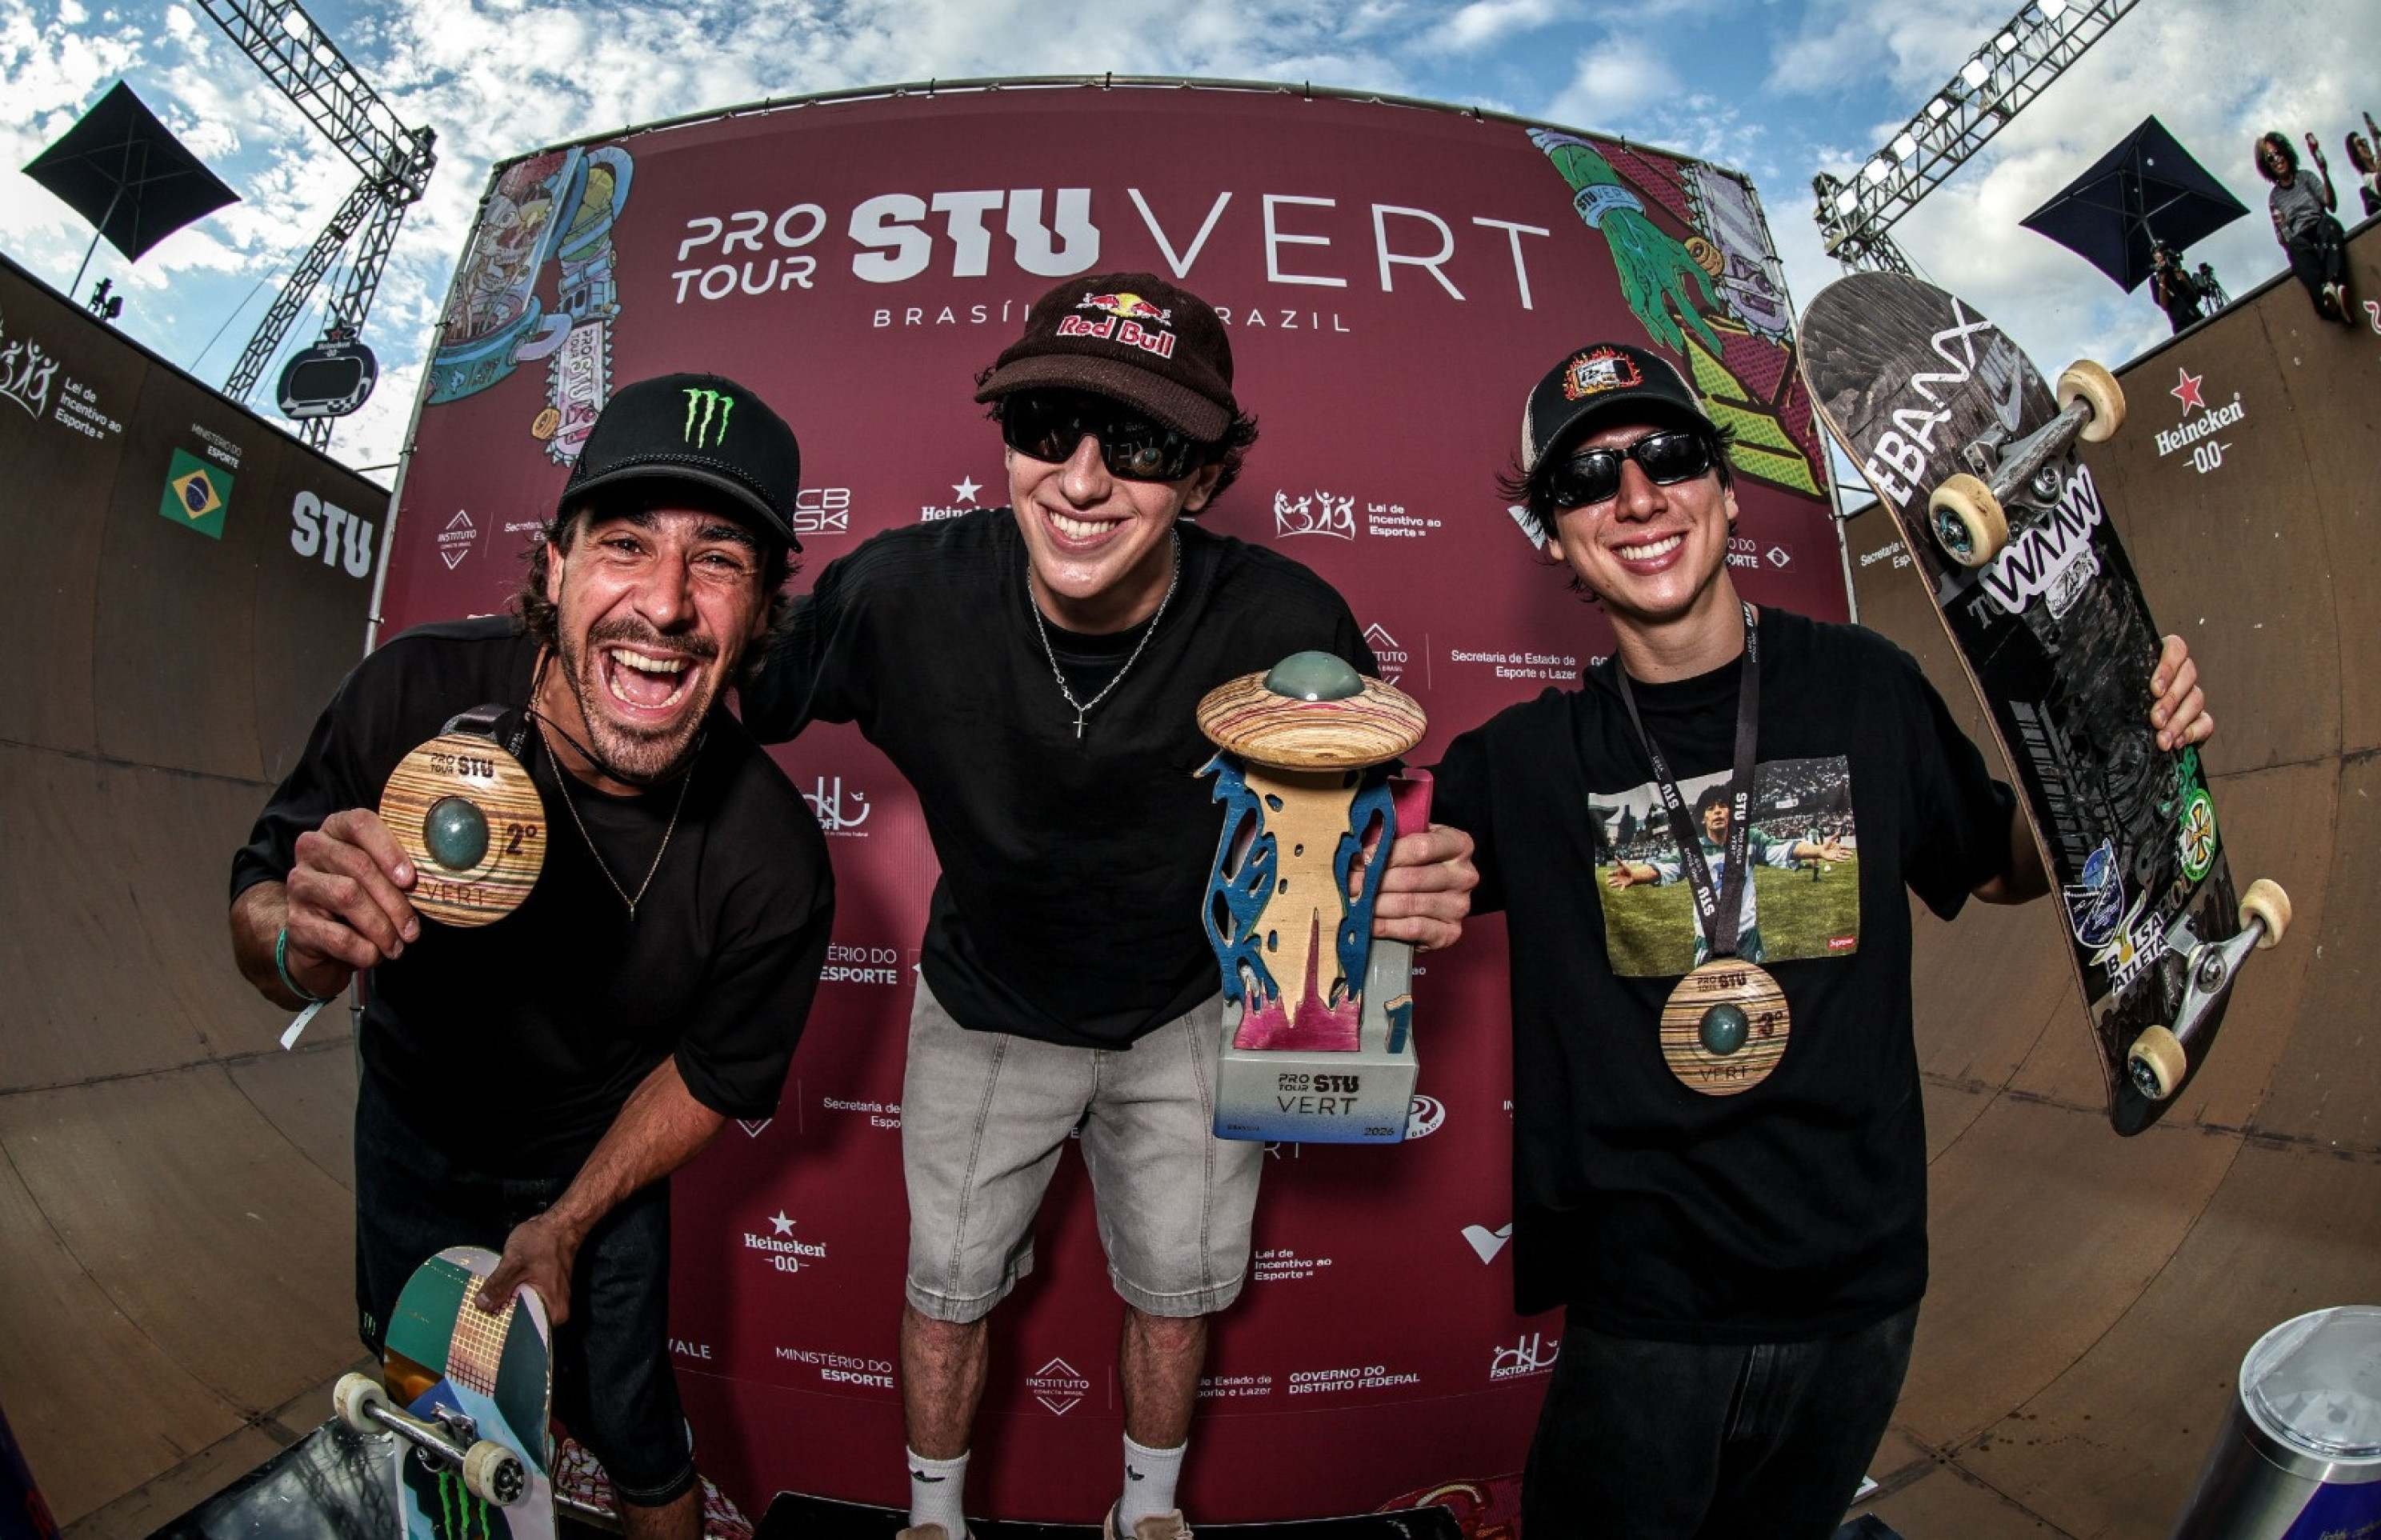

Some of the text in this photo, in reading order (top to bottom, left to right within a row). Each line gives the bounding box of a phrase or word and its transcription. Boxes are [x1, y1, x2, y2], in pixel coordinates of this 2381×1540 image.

[678, 203, 826, 262] PRO
[848, 188, 1551, 310] STU VERT
[671, 255, 817, 305] TOUR
[874, 301, 1030, 327] BRASÍ
[1057, 315, 1176, 359] Red Bull
[65, 377, 97, 402] Lei de
[1864, 295, 1992, 507] EBANX
[61, 392, 122, 433] Incentivo ao
[55, 408, 95, 438] Esporte
[2155, 399, 2245, 457] Heineken
[1368, 502, 1404, 514] Lei de
[1369, 514, 1441, 528] Incentivo ao
[291, 491, 374, 578] STU
[1370, 526, 1416, 538] Esporte
[1727, 553, 1759, 569] ORTE
[1451, 650, 1575, 666] Secretaria de Estado de
[1495, 666, 1536, 679] Esporte
[1549, 669, 1577, 679] Lazer
[458, 756, 494, 778] STU
[1735, 792, 1748, 821] STU
[423, 882, 487, 905] VERT
[870, 949, 897, 964] DO
[2114, 934, 2171, 993] ATLETA
[819, 966, 898, 985] ESPORTE
[1719, 971, 1747, 989] STU
[1279, 1074, 1311, 1084] PRO
[1699, 1065, 1749, 1082] VERT
[1279, 1074, 1359, 1094] TOUR STU
[823, 1098, 882, 1114] Secretaria
[1277, 1096, 1359, 1115] VERT
[871, 1115, 901, 1130] Espo
[743, 1233, 826, 1258] Heineken
[1255, 1249, 1294, 1259] Lei de
[1255, 1258, 1332, 1270] Incentivo ao
[1255, 1270, 1303, 1282] Esporte
[776, 1346, 892, 1374] MINISTÉRIO DO
[820, 1369, 894, 1388] ESPORTE
[1026, 1378, 1090, 1389] INSTITUTO
[1215, 1374, 1255, 1386] Estado
[1257, 1374, 1271, 1385] de
[1290, 1365, 1385, 1383] GOVERNO DO
[1239, 1386, 1271, 1398] Lazer
[1289, 1373, 1421, 1395] DISTRITO FEDERAL
